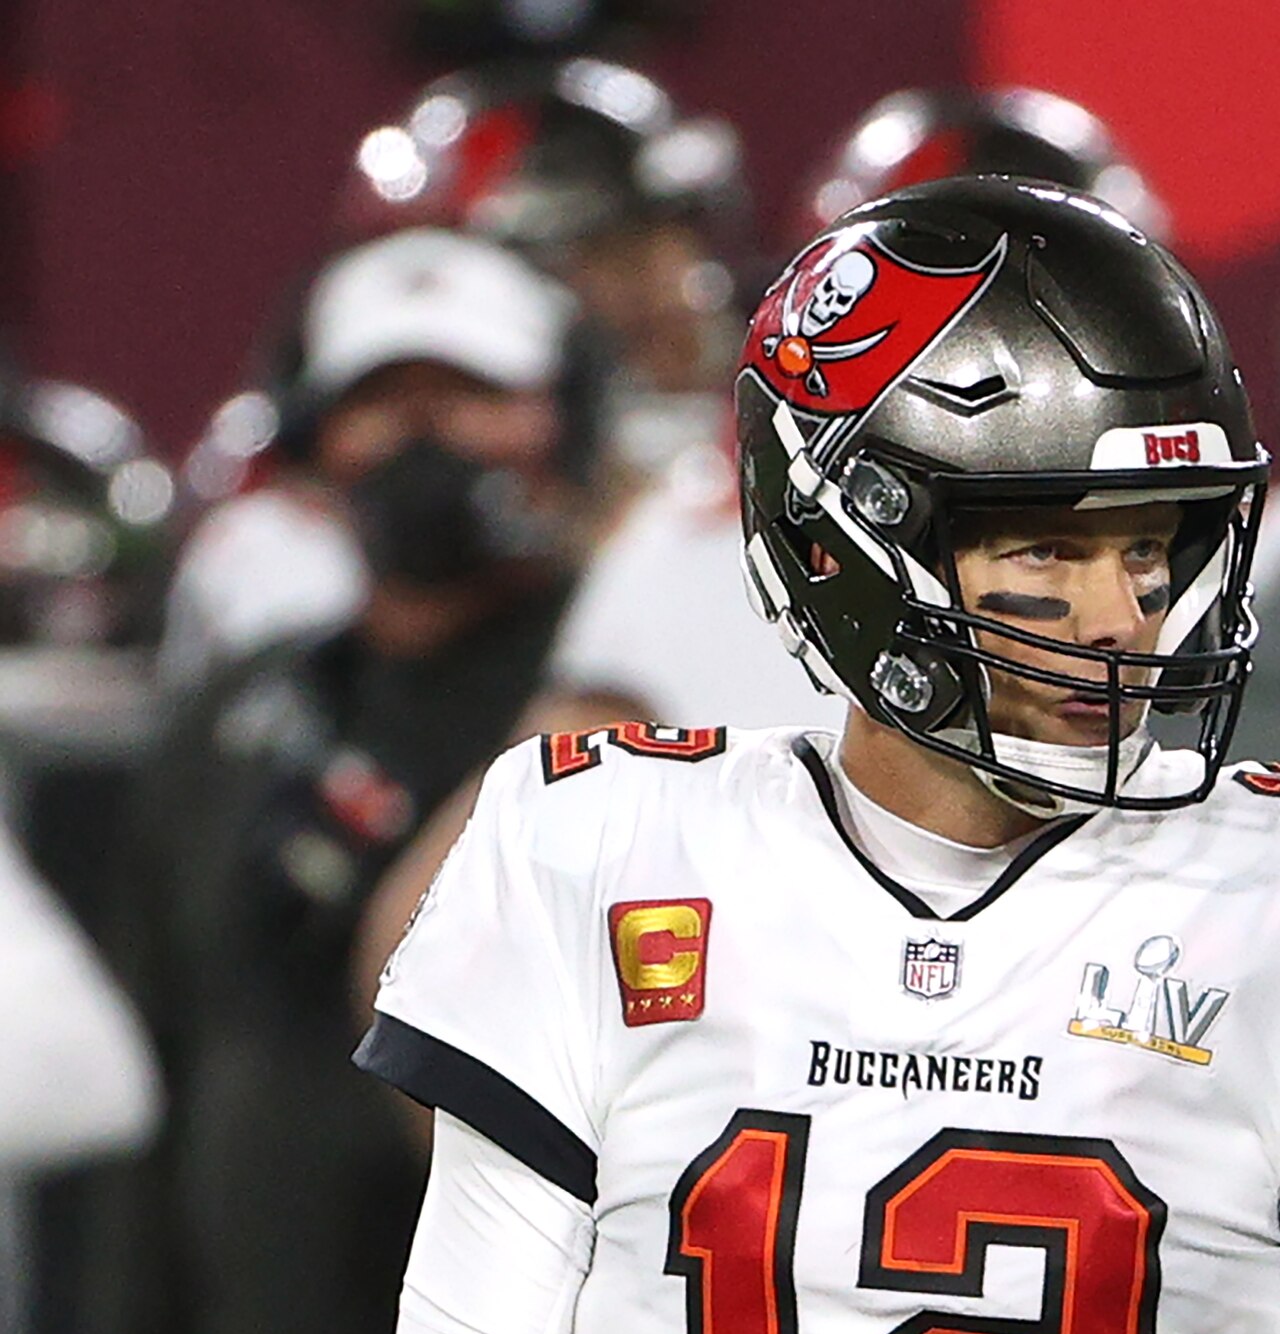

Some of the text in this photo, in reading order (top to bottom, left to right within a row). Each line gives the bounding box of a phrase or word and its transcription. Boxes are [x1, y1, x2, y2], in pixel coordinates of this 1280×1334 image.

[616, 905, 701, 990] C
[909, 963, 951, 993] NFL
[807, 1040, 1043, 1101] BUCCANEERS
